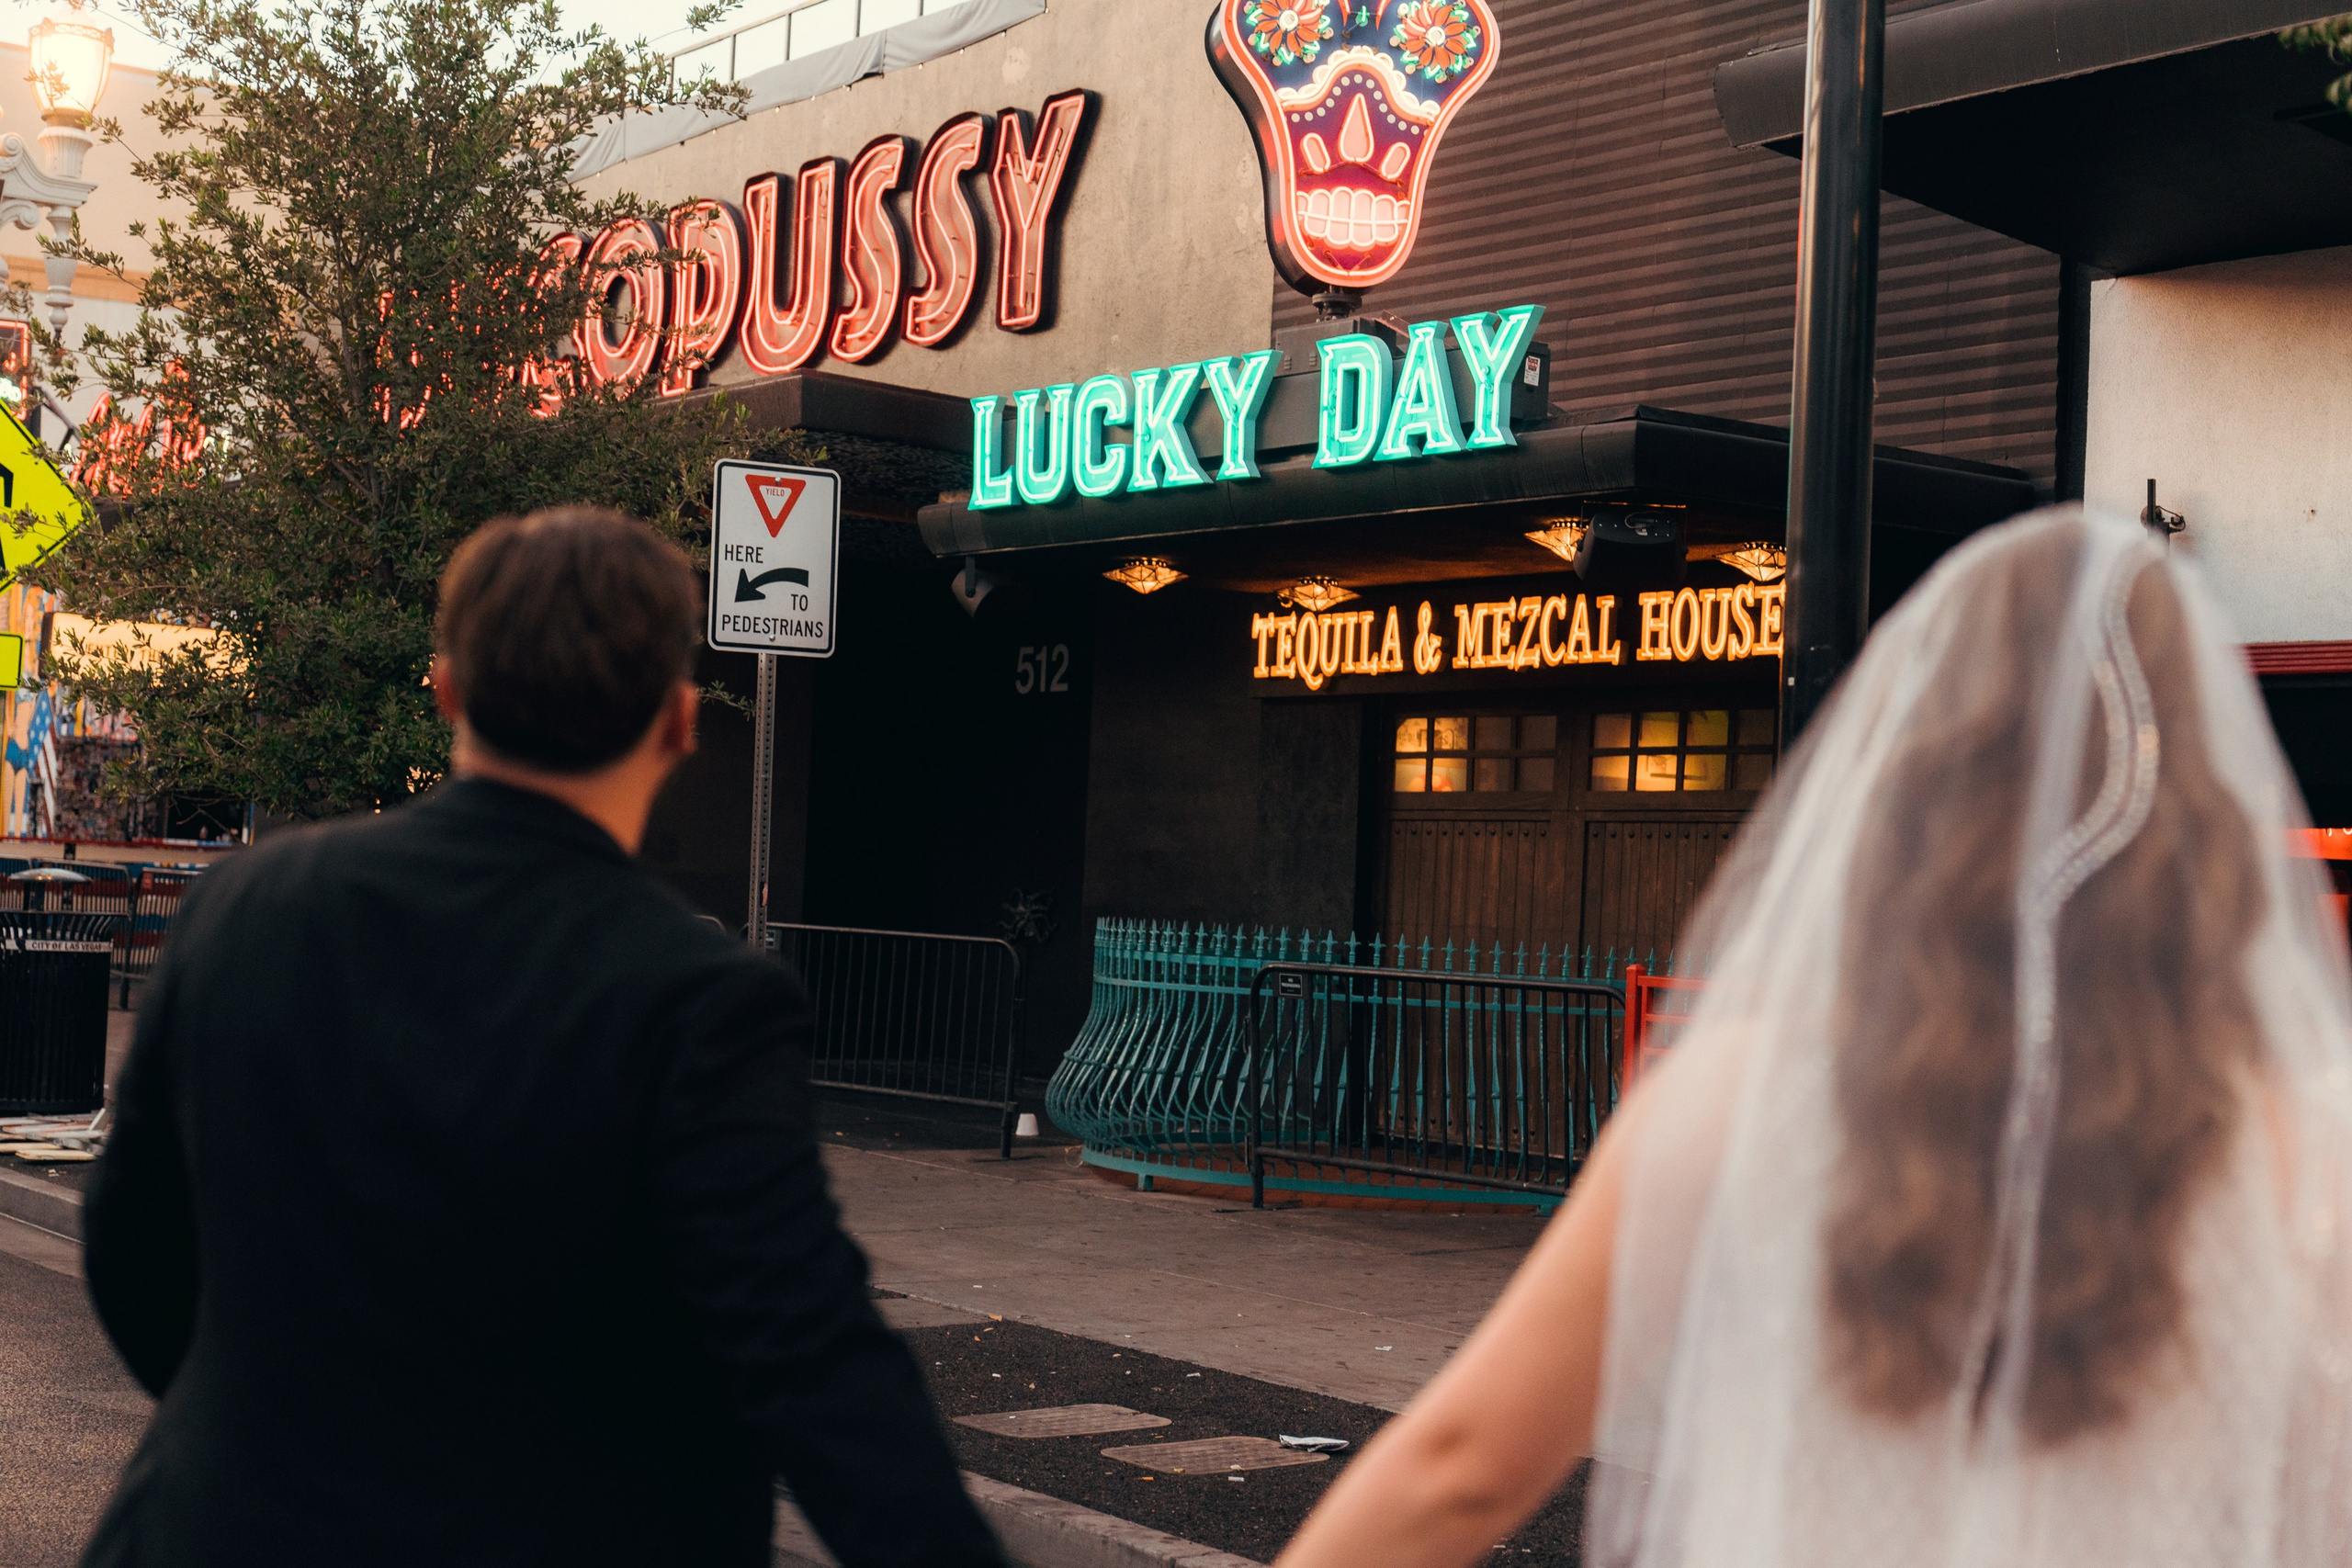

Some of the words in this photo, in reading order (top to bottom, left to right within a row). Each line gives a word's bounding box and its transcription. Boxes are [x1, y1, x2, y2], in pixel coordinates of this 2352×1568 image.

[967, 349, 1283, 511] LUCKY
[1311, 304, 1546, 469] DAY
[765, 487, 786, 497] YIELD
[724, 544, 764, 564] HERE
[790, 593, 808, 612] TO
[721, 614, 824, 638] PEDESTRIANS
[1251, 605, 1404, 691] TEQUILA
[1413, 600, 1442, 675] &
[1453, 593, 1622, 672] MEZCAL
[1636, 579, 1786, 661] HOUSE
[1015, 643, 1069, 694] 512
[31, 941, 50, 950] CITY
[51, 942, 62, 950] OF
[64, 942, 80, 951] LAS
[81, 942, 102, 951] VEGAS
